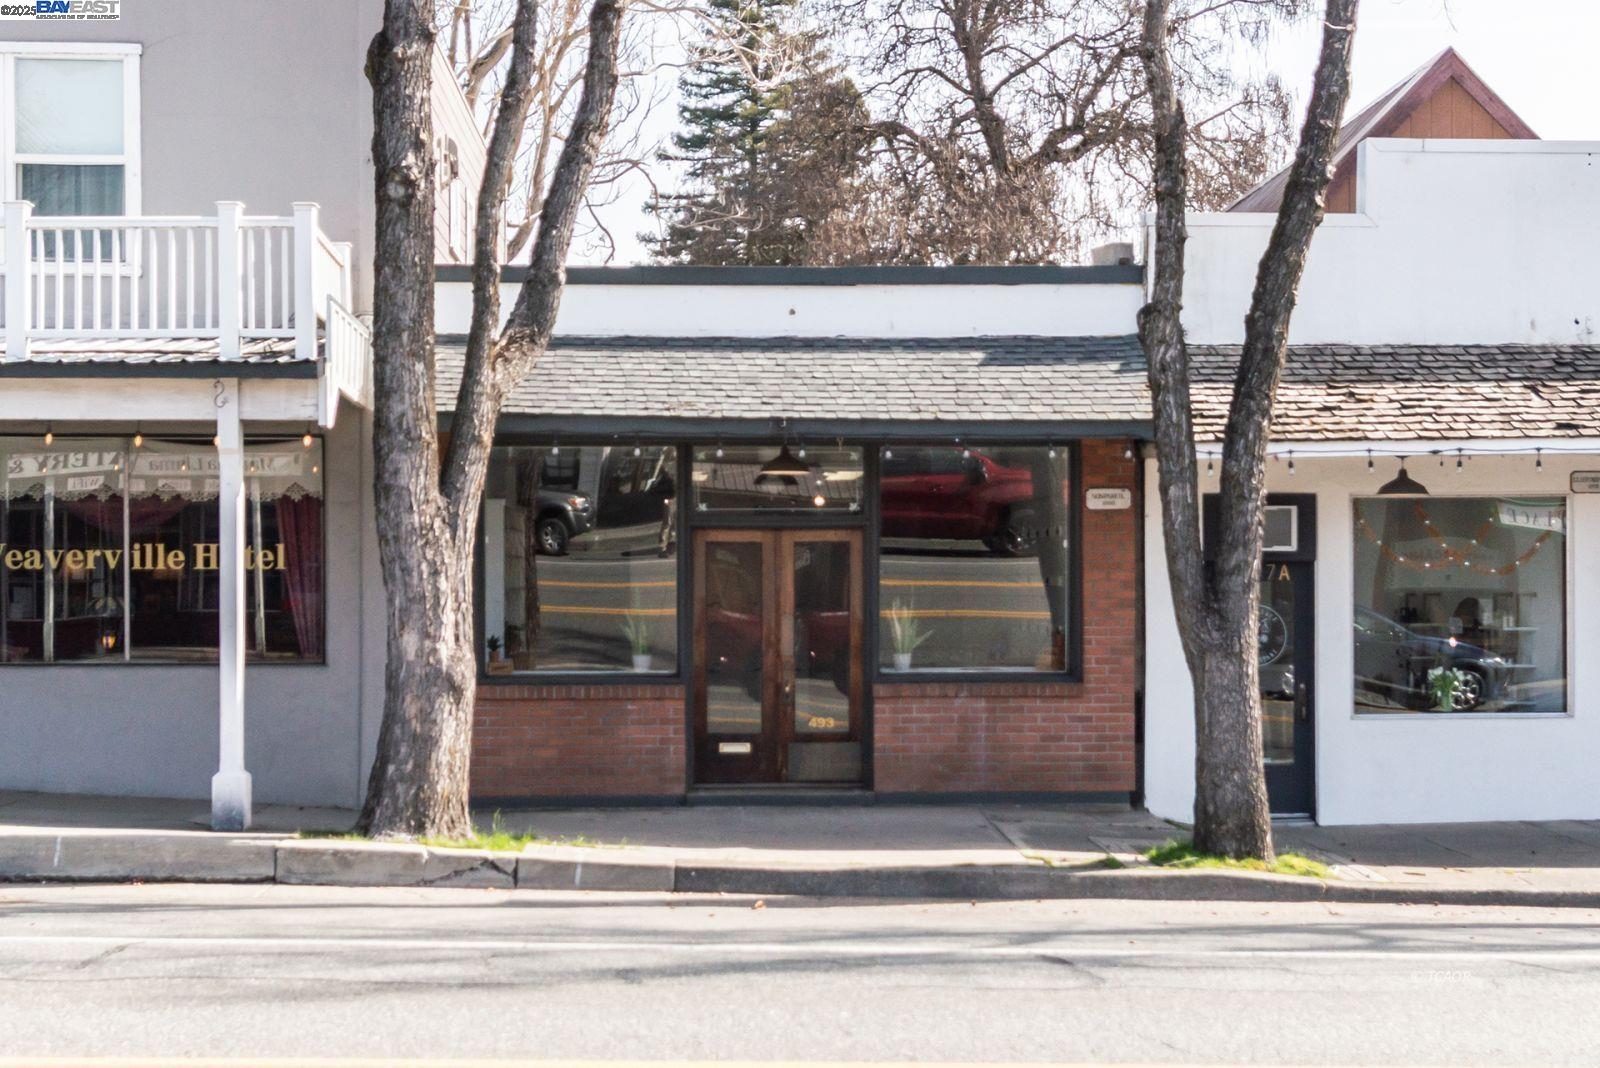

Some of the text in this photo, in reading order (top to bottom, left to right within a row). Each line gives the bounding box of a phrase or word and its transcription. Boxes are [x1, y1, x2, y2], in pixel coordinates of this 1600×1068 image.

[0, 543, 286, 570] eaverville Htel
[809, 717, 834, 728] 493
